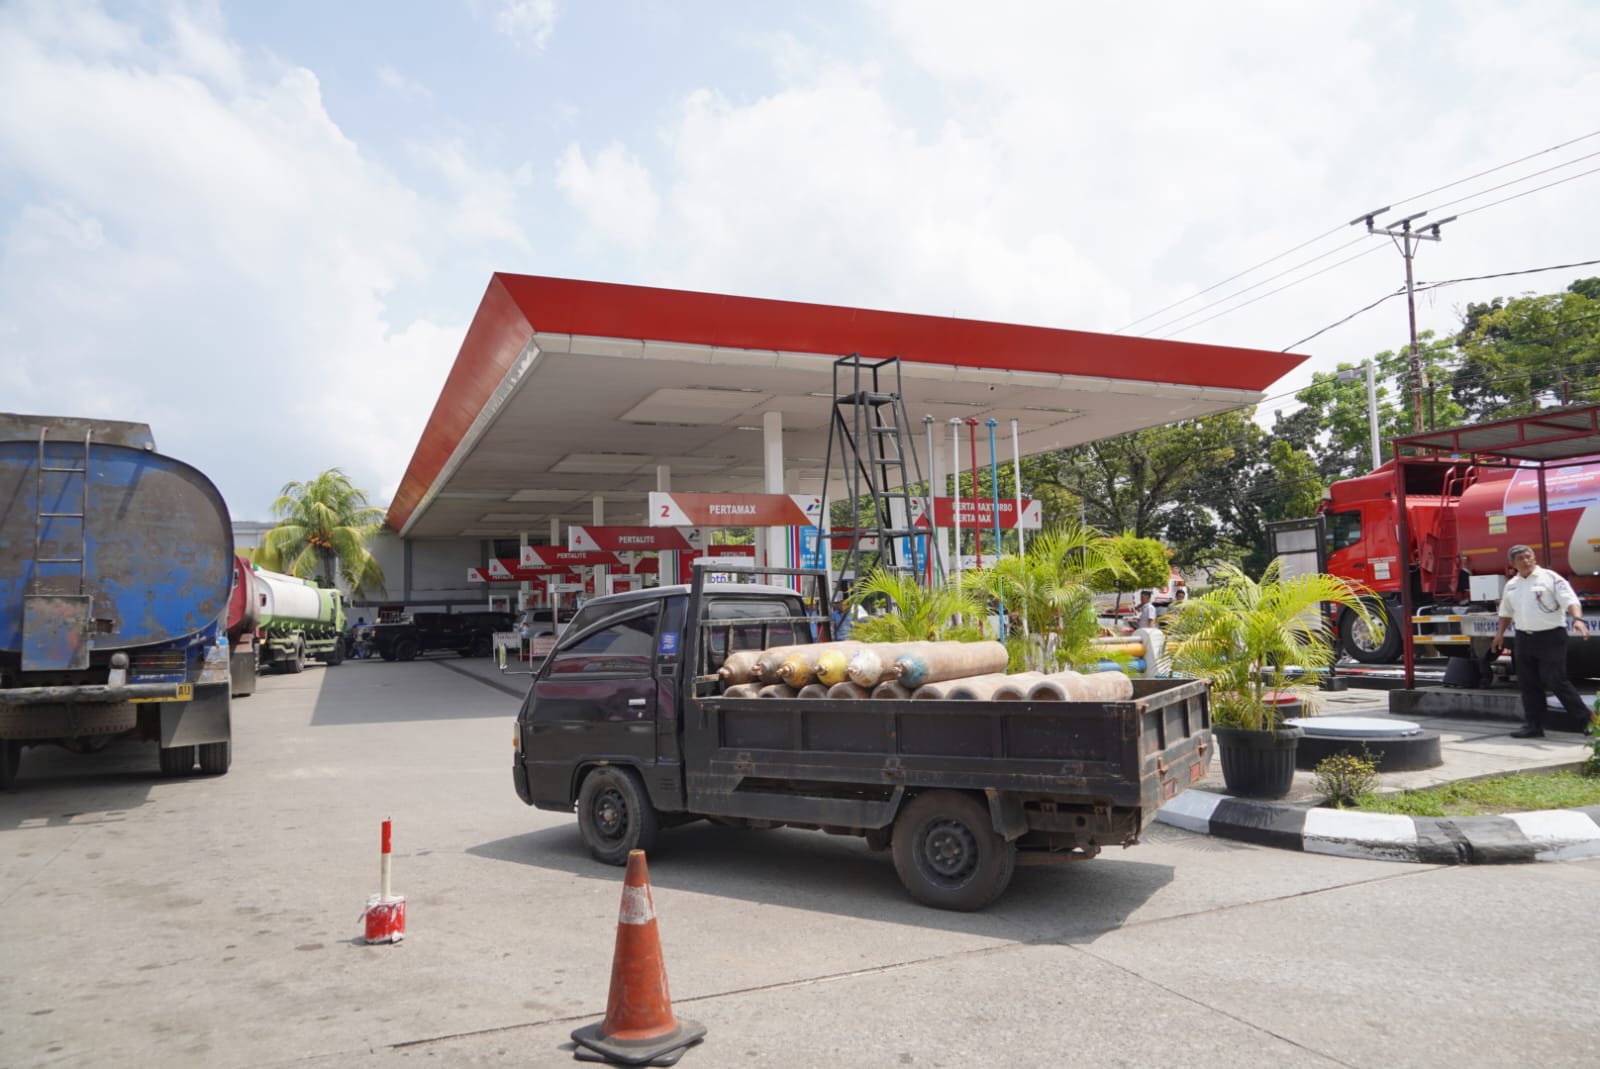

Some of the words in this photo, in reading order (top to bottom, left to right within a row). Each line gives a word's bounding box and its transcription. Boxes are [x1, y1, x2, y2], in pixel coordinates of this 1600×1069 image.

[661, 505, 670, 517] 2
[709, 504, 756, 514] PERTAMAX
[1033, 511, 1039, 522] 1
[575, 535, 582, 545] 4
[618, 535, 655, 544] PERTALITE
